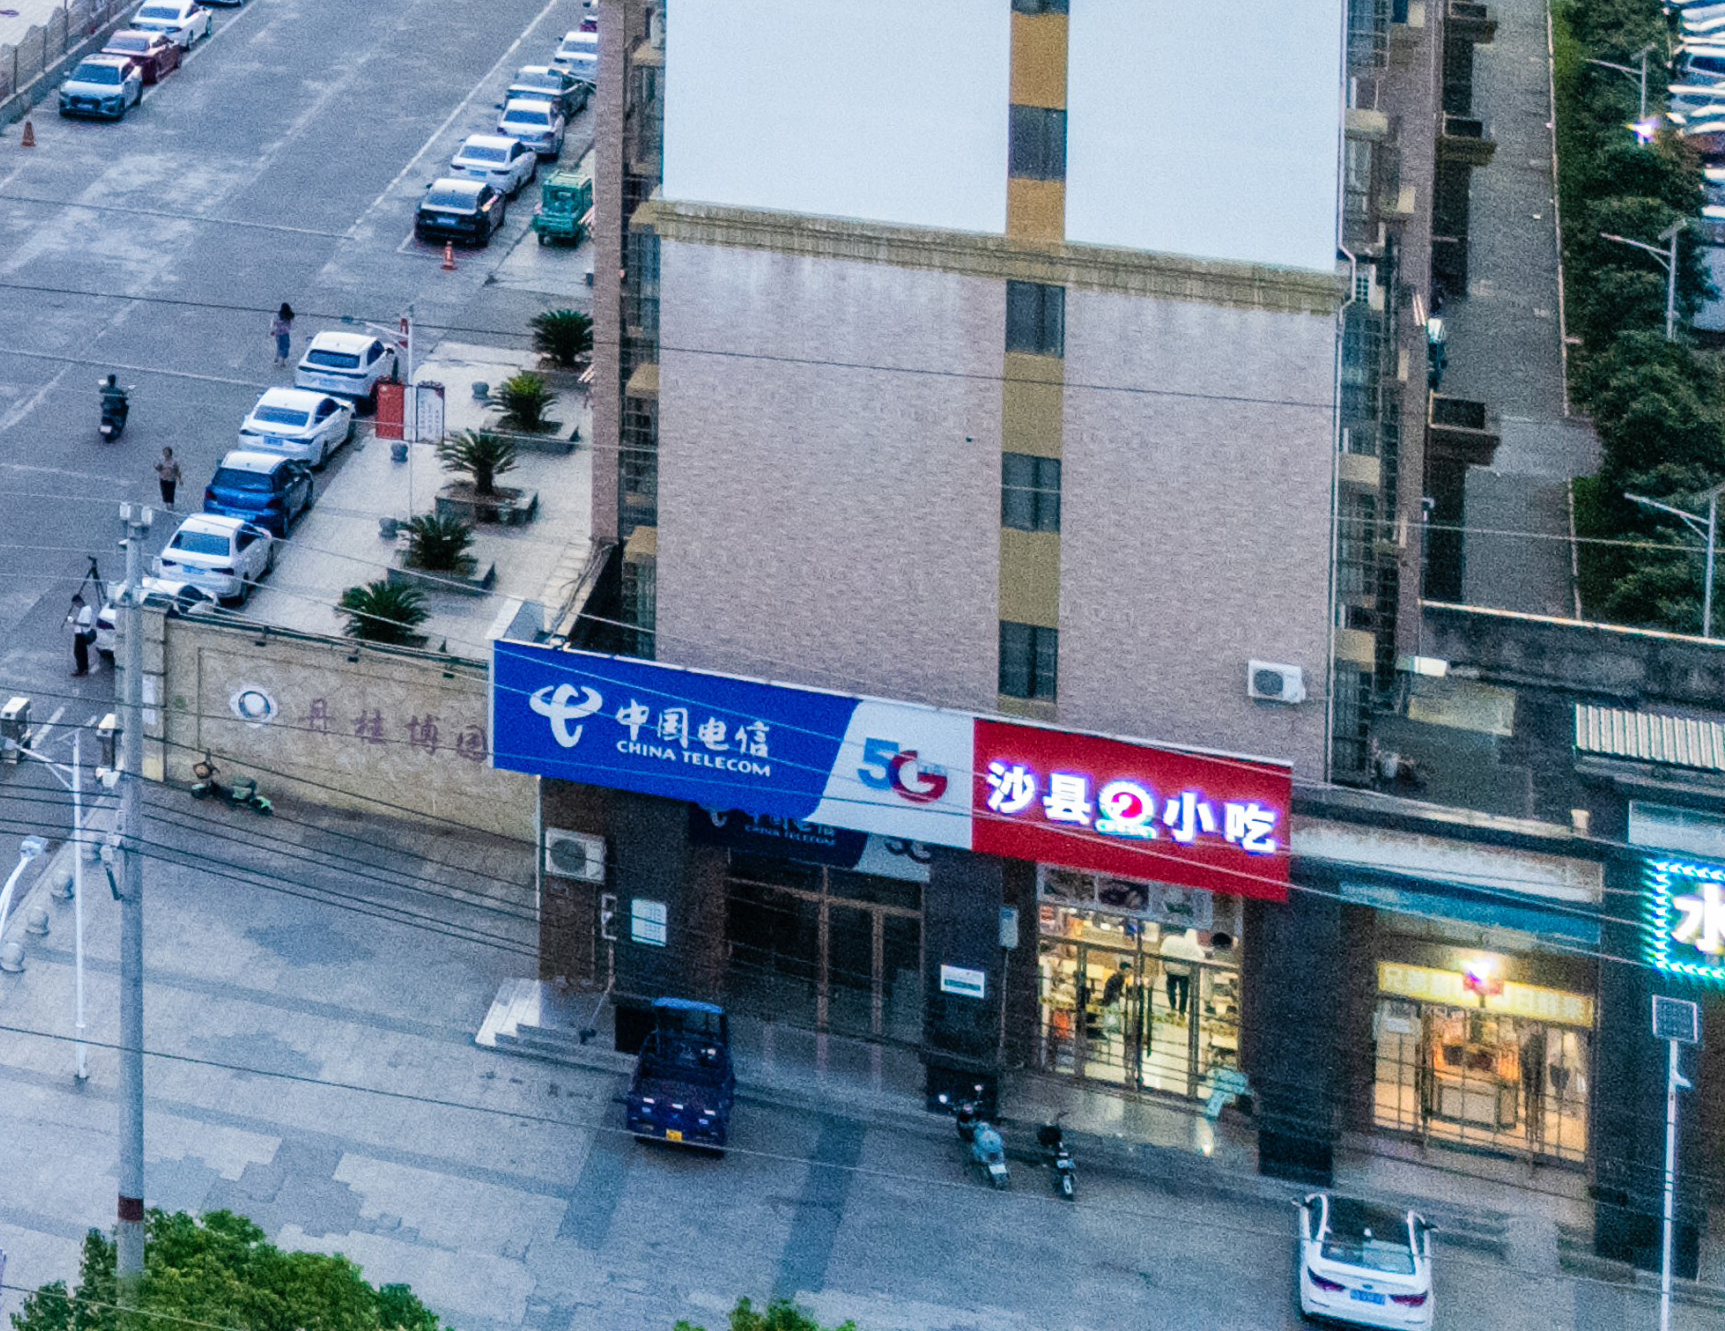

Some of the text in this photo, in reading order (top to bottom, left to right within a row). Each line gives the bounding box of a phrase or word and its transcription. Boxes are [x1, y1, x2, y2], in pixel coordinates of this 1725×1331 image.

[615, 697, 771, 759] 中国电信
[615, 739, 772, 779] CHINA TELECOM
[858, 736, 949, 803] 5G
[987, 759, 1280, 856] 沙县 小吃
